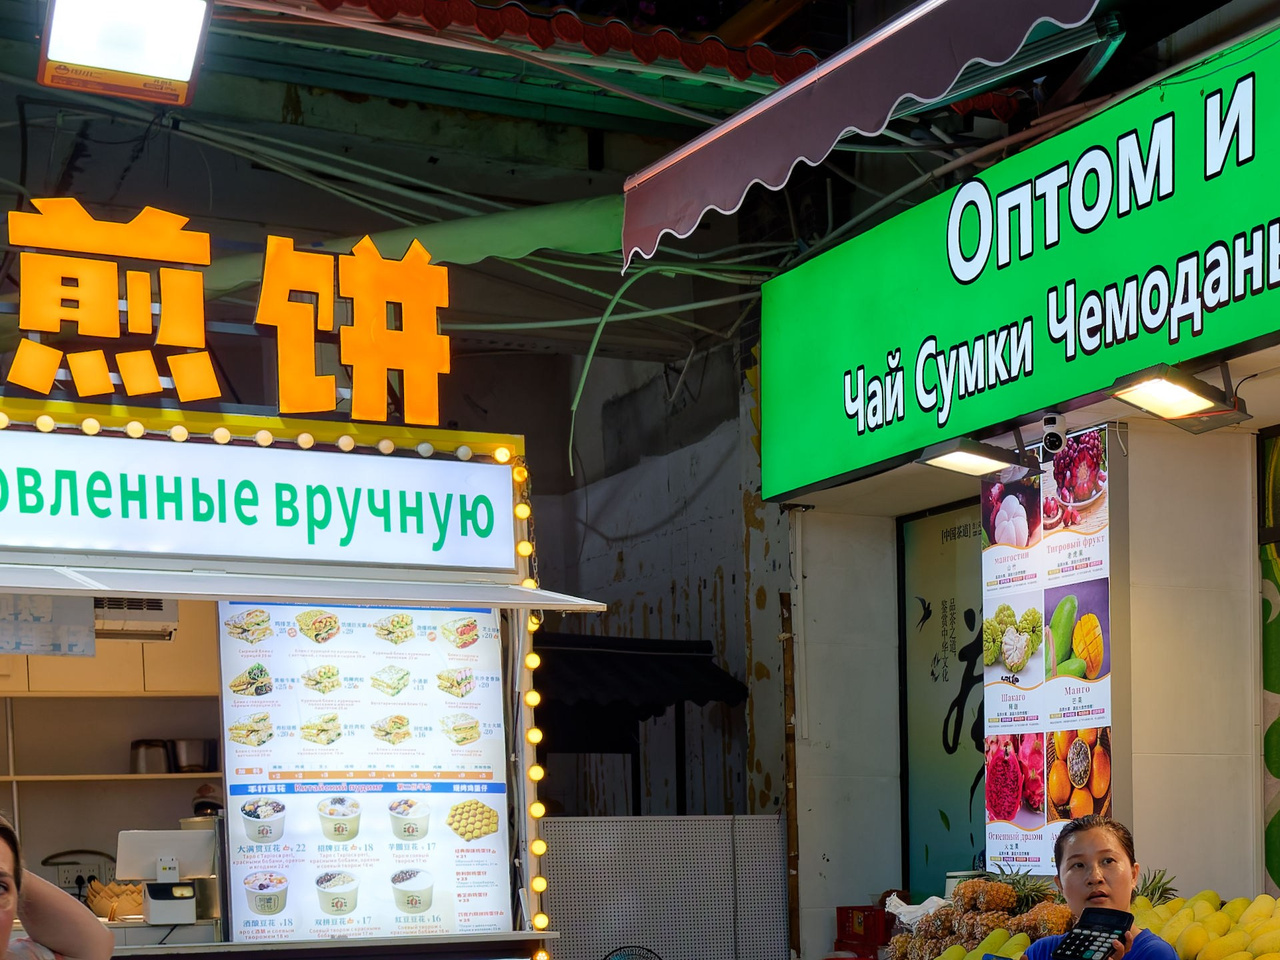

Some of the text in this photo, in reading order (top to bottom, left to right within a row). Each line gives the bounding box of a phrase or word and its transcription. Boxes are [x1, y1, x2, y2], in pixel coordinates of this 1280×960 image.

[947, 112, 1175, 286] Оптом
[1205, 73, 1256, 179] и
[7, 198, 451, 427] 煎饼
[843, 350, 905, 436] Чай
[914, 315, 1036, 431] Сумки
[275, 480, 496, 551] вручную
[995, 551, 1029, 565] мангостин
[1047, 534, 1105, 554] Тигровый фрукт
[1064, 685, 1091, 696] Манго
[237, 844, 281, 853] 大满贯豆花
